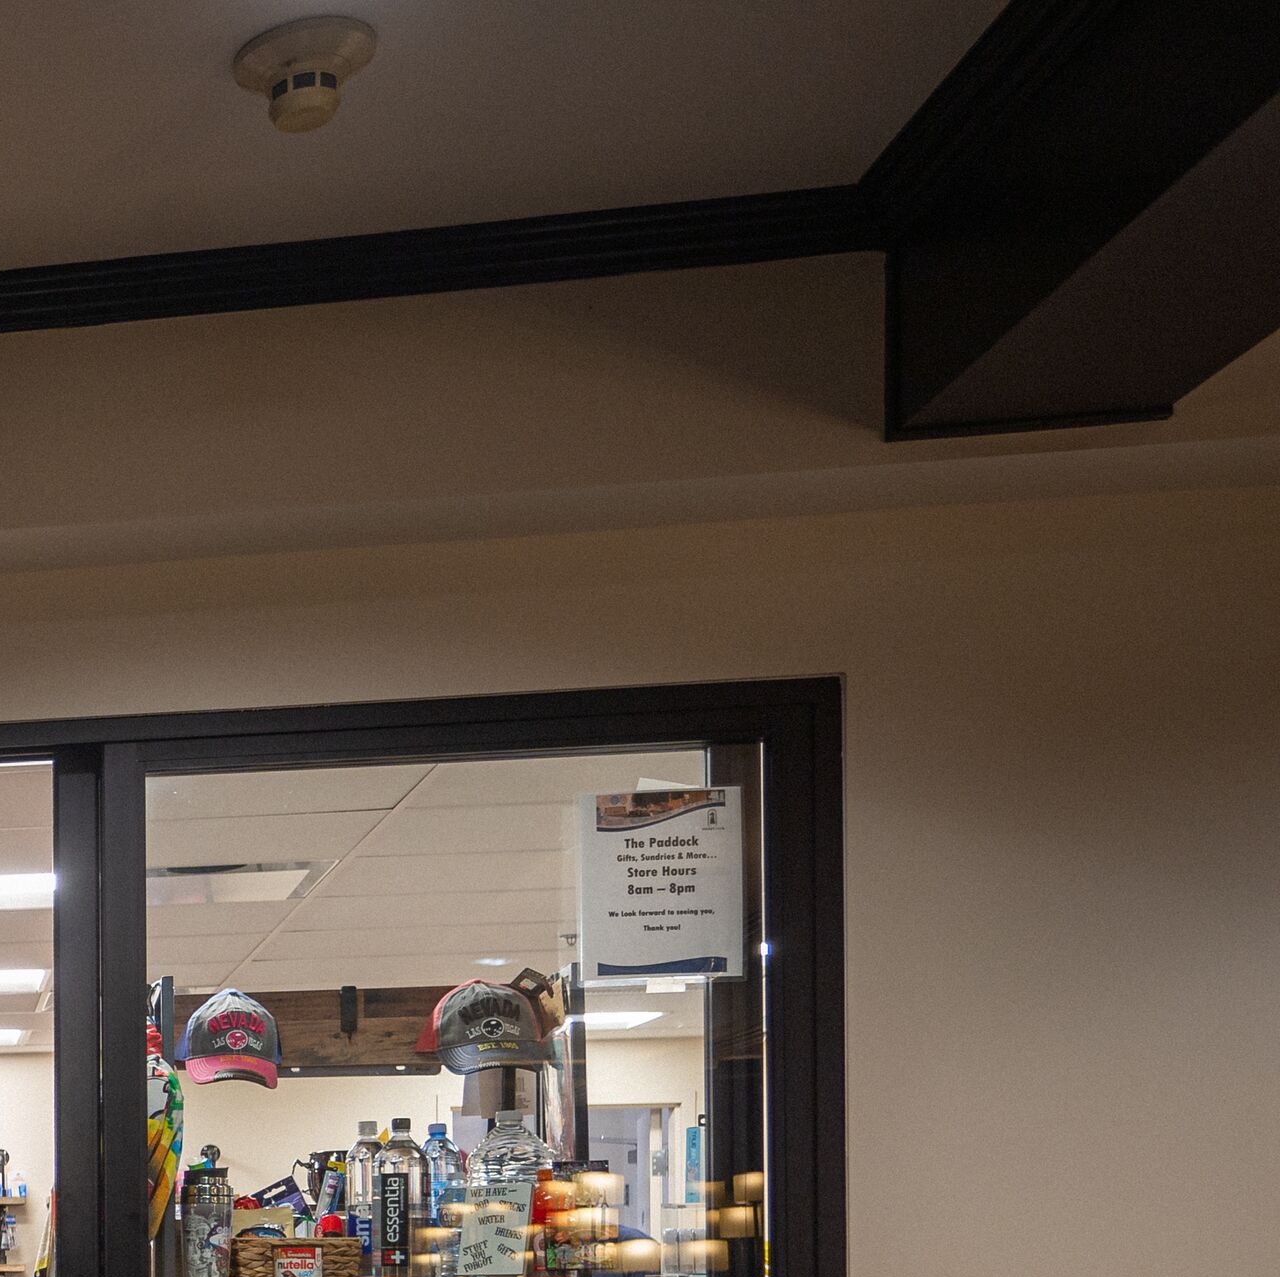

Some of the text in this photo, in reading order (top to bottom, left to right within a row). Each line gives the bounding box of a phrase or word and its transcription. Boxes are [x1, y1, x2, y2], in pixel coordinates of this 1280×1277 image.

[624, 836, 699, 849] The Paddock
[617, 854, 638, 862] Gifts,
[640, 852, 675, 862] Sundries
[686, 851, 717, 860] More...
[627, 866, 696, 878] Store Hours
[628, 884, 653, 895] 8am
[669, 883, 695, 896] 8pm
[207, 1011, 266, 1038] NEVADA
[212, 1037, 225, 1048] LAS
[470, 1188, 483, 1197] WE
[385, 1177, 399, 1243] essentia
[478, 1215, 505, 1226] WATER
[495, 1227, 523, 1240] DRINKS
[463, 1240, 488, 1256] STUFF
[277, 1260, 314, 1270] nutella
[464, 1256, 493, 1272] FORGOT
